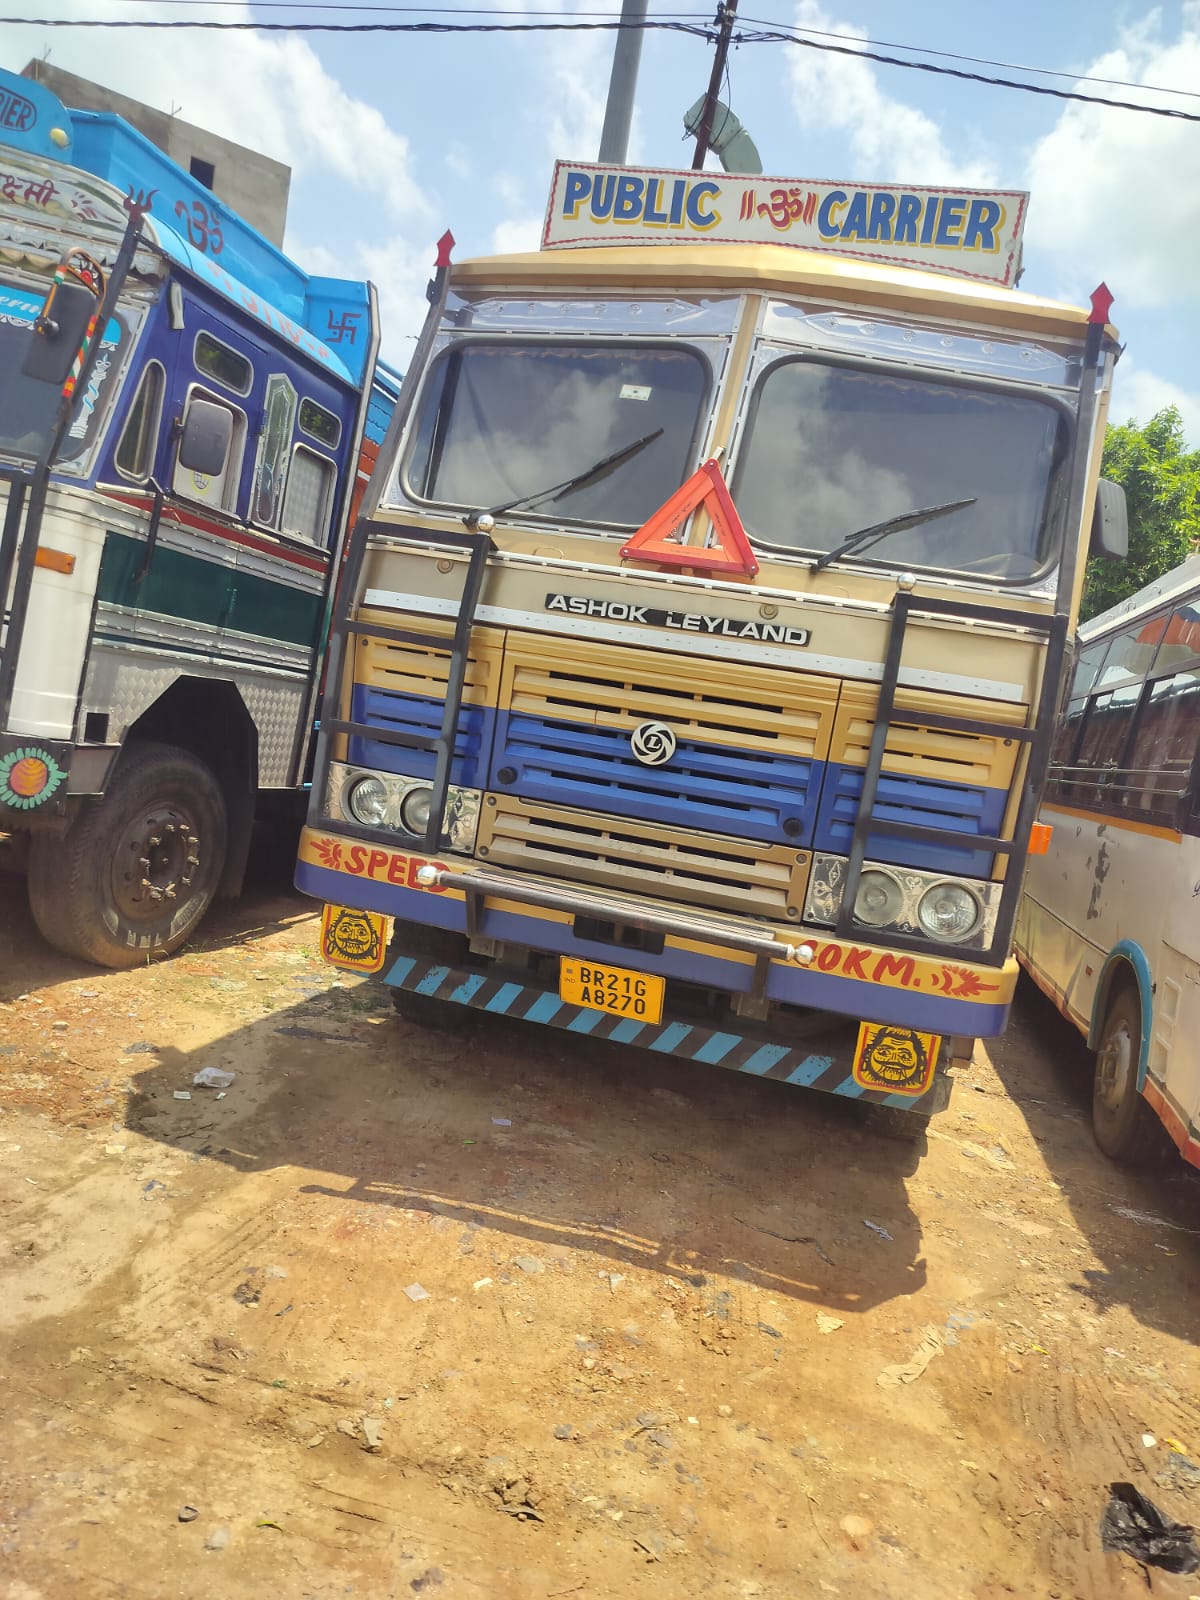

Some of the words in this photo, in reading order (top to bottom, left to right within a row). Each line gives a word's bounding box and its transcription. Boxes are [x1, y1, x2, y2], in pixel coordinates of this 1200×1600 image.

[562, 172, 721, 230] PUBLIC
[817, 190, 1005, 253] CARRIER
[547, 594, 651, 624] ASHOK
[665, 610, 809, 646] LEYLAND
[580, 966, 646, 997] BR21G
[581, 986, 646, 1015] A8270
